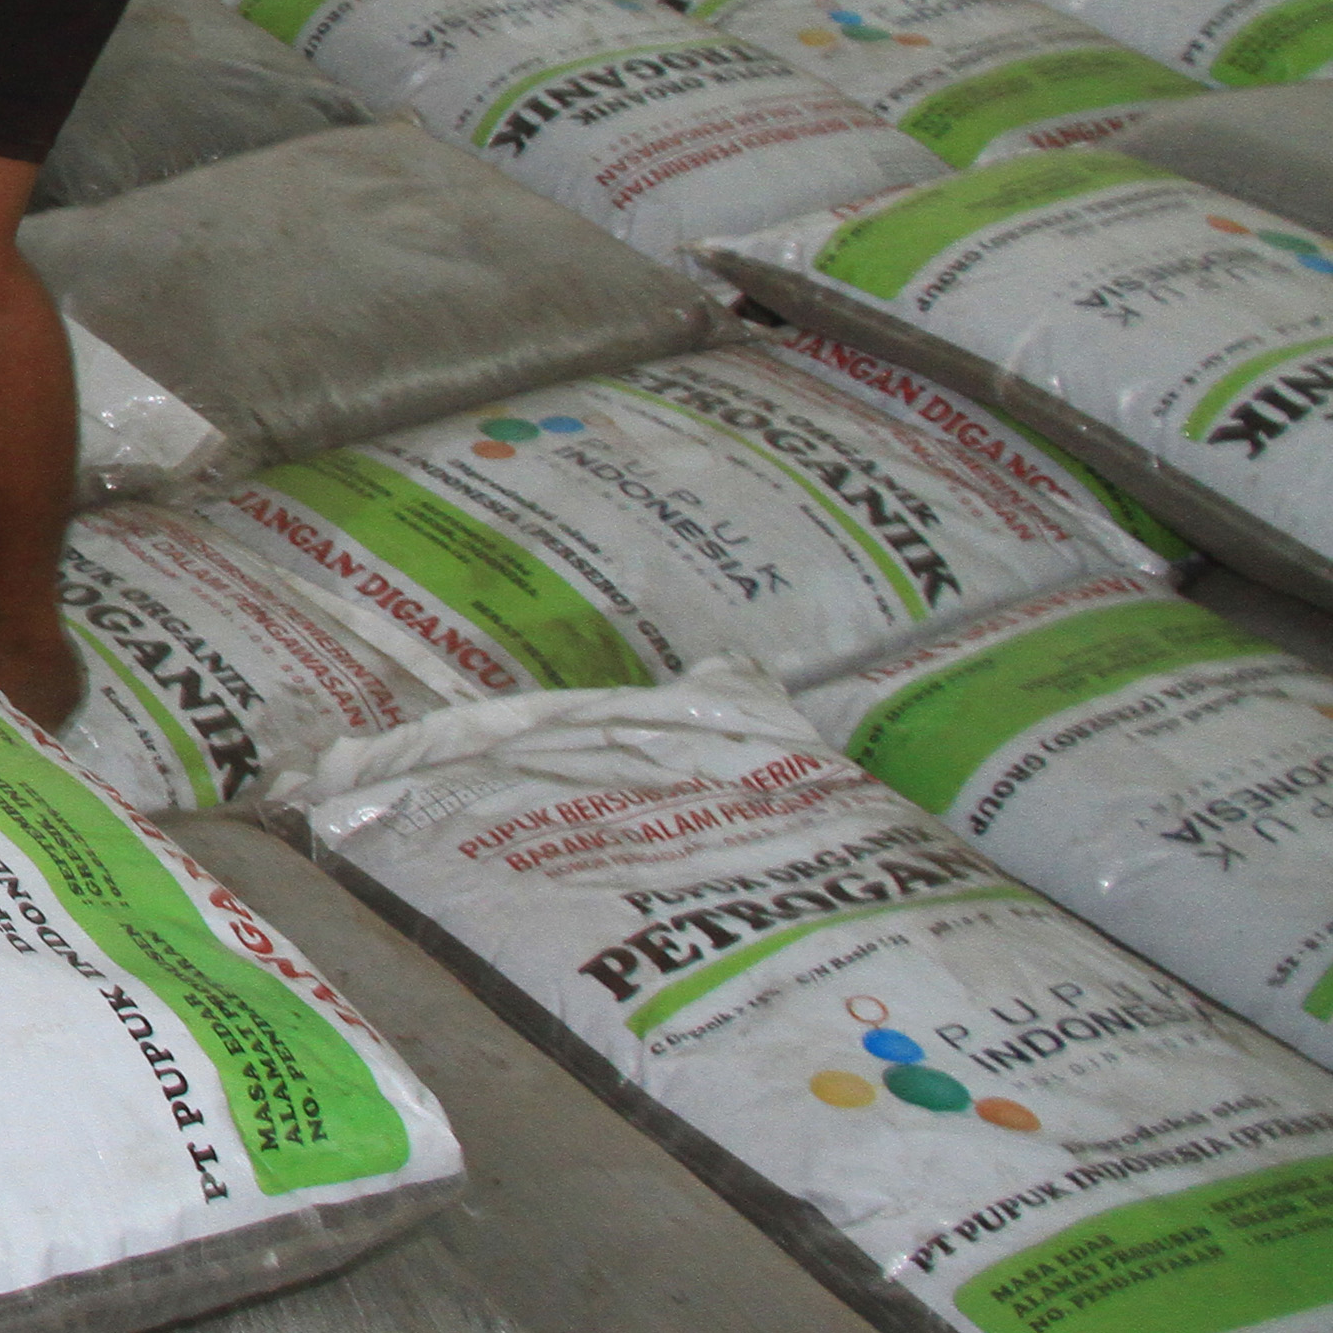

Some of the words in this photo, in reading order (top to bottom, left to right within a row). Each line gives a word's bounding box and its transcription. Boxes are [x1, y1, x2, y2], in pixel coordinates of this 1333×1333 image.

[782, 326, 926, 405] JANGAN
[228, 488, 367, 580] JANGAN
[354, 571, 519, 692] DIGANCU
[504, 830, 621, 874] BARANG
[98, 983, 205, 1132] PUPUK
[183, 992, 246, 1058] EDAR
[237, 1025, 305, 1147] ALAMAT
[243, 1060, 281, 1154] MASA
[301, 1086, 329, 1145] NO.
[186, 1140, 230, 1205] PT
[909, 1233, 958, 1274] PT
[953, 1180, 1072, 1244] PUPUK
